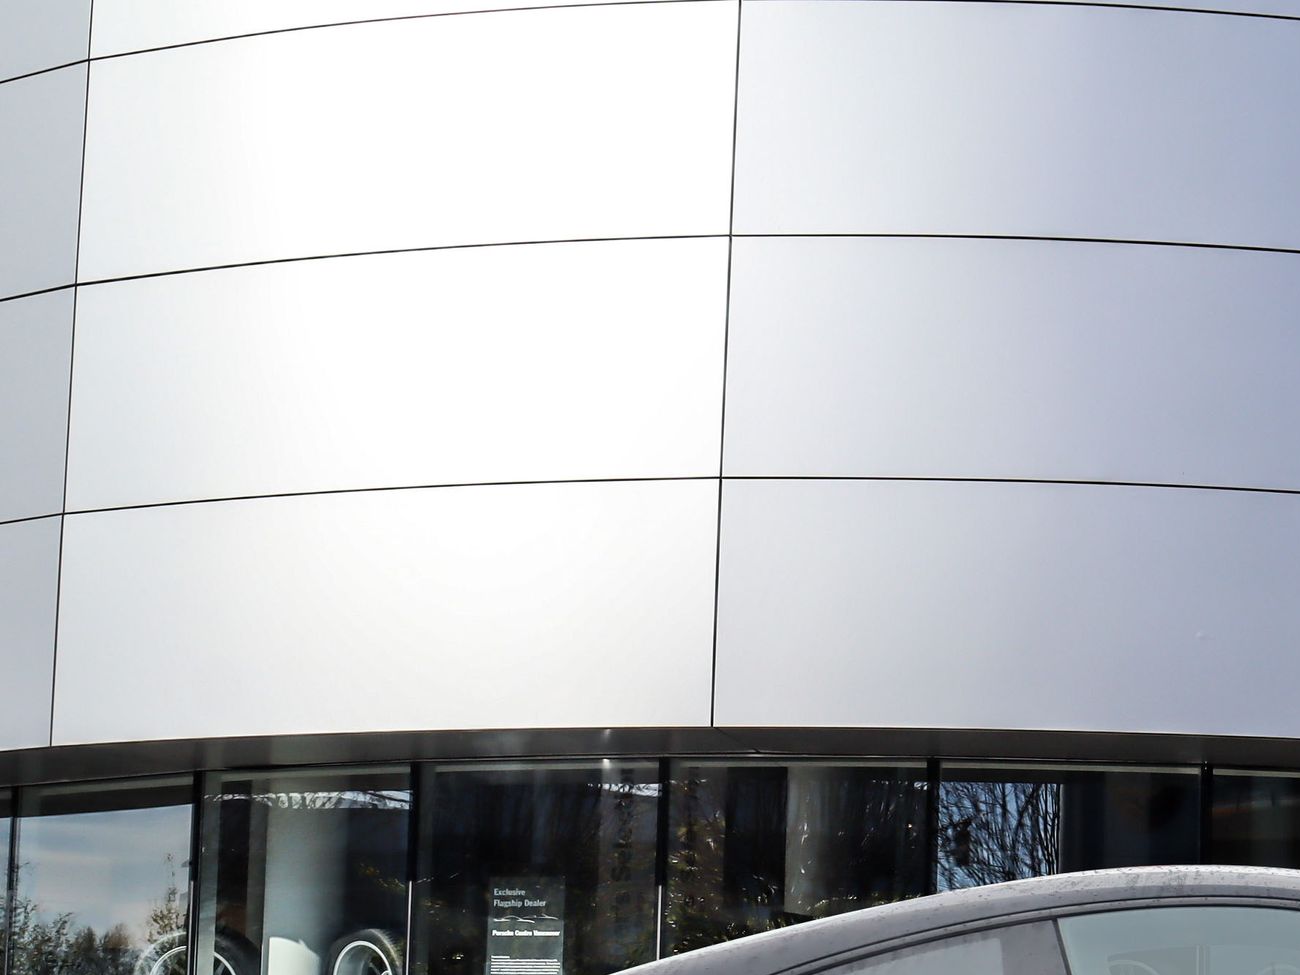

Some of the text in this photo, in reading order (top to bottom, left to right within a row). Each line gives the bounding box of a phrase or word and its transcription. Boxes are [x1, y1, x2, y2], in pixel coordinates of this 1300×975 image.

[493, 888, 526, 896] Exclusive
[493, 899, 546, 908] Flagship Dealer
